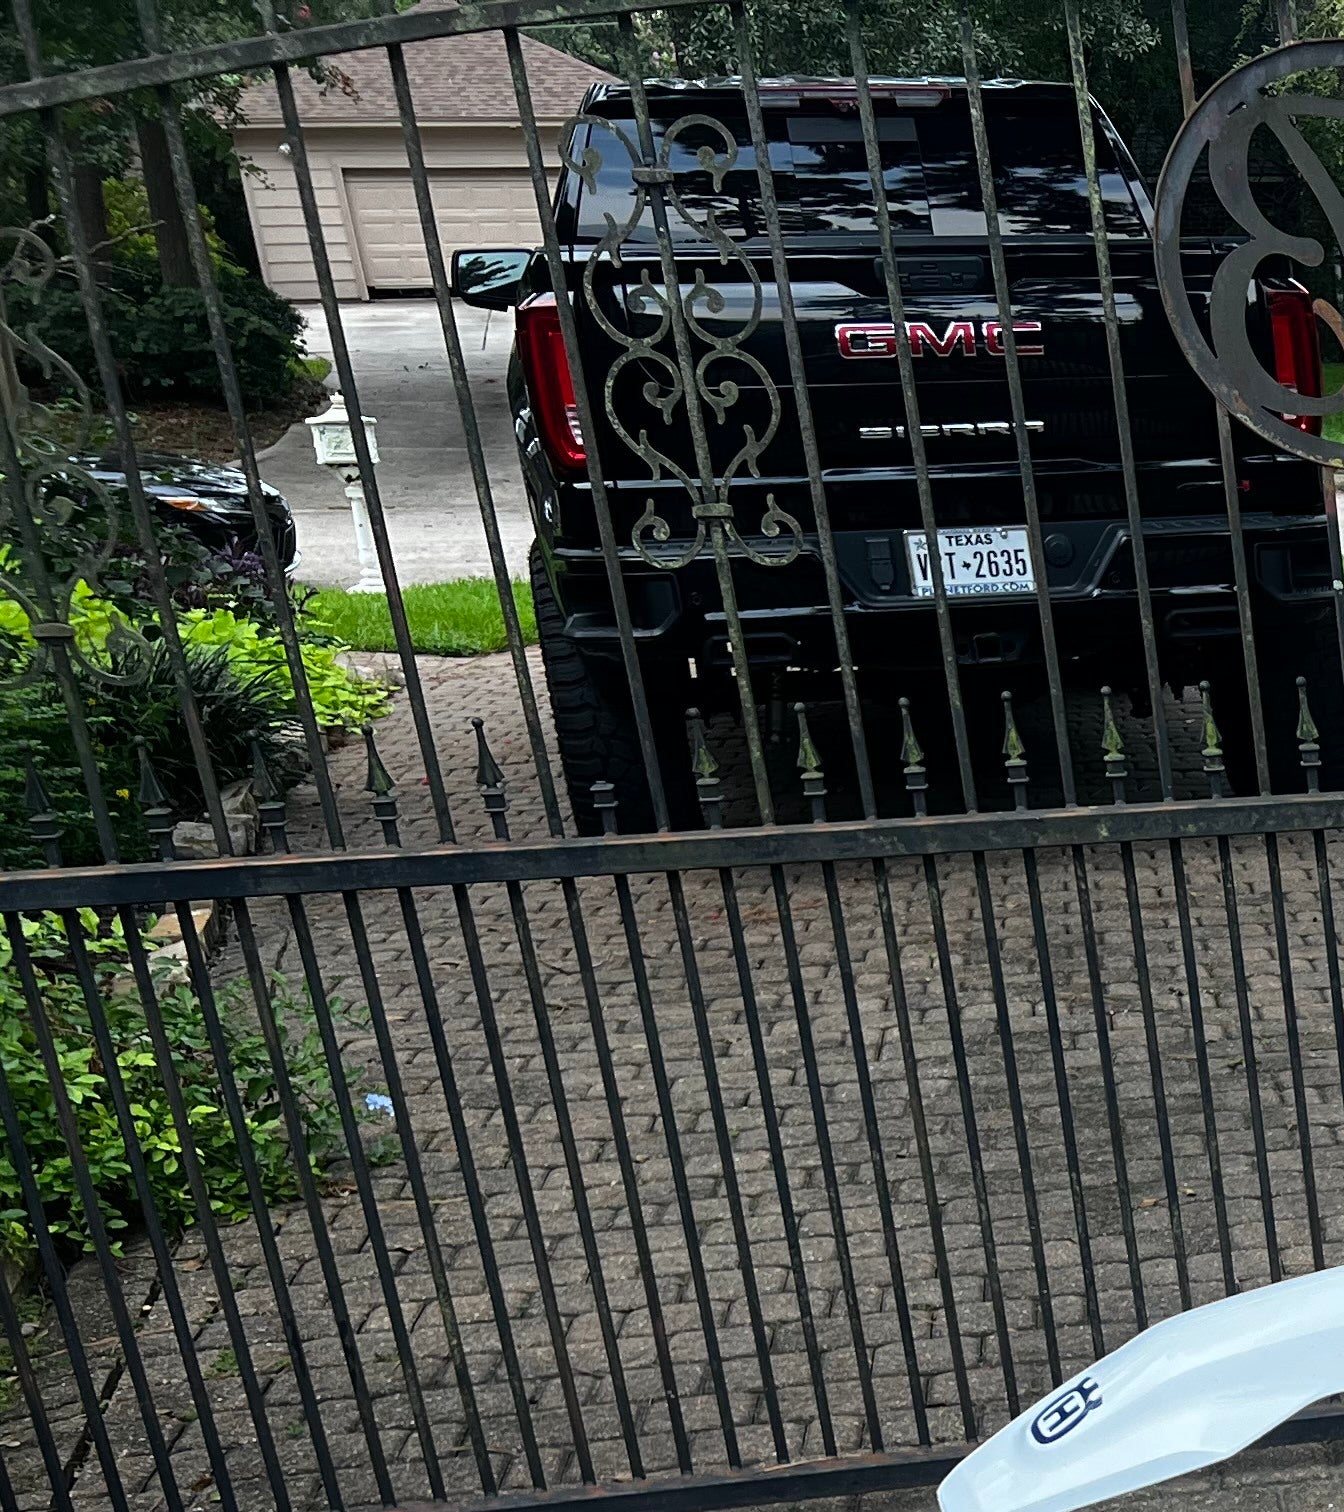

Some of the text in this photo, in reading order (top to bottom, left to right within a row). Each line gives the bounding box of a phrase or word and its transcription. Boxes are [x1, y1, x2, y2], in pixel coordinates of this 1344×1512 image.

[834, 321, 1044, 359] GMC
[859, 420, 1044, 439] SIERRA
[945, 533, 993, 546] TEXAS
[917, 552, 956, 580] VT
[921, 582, 1030, 596] PLNETFORD.COM
